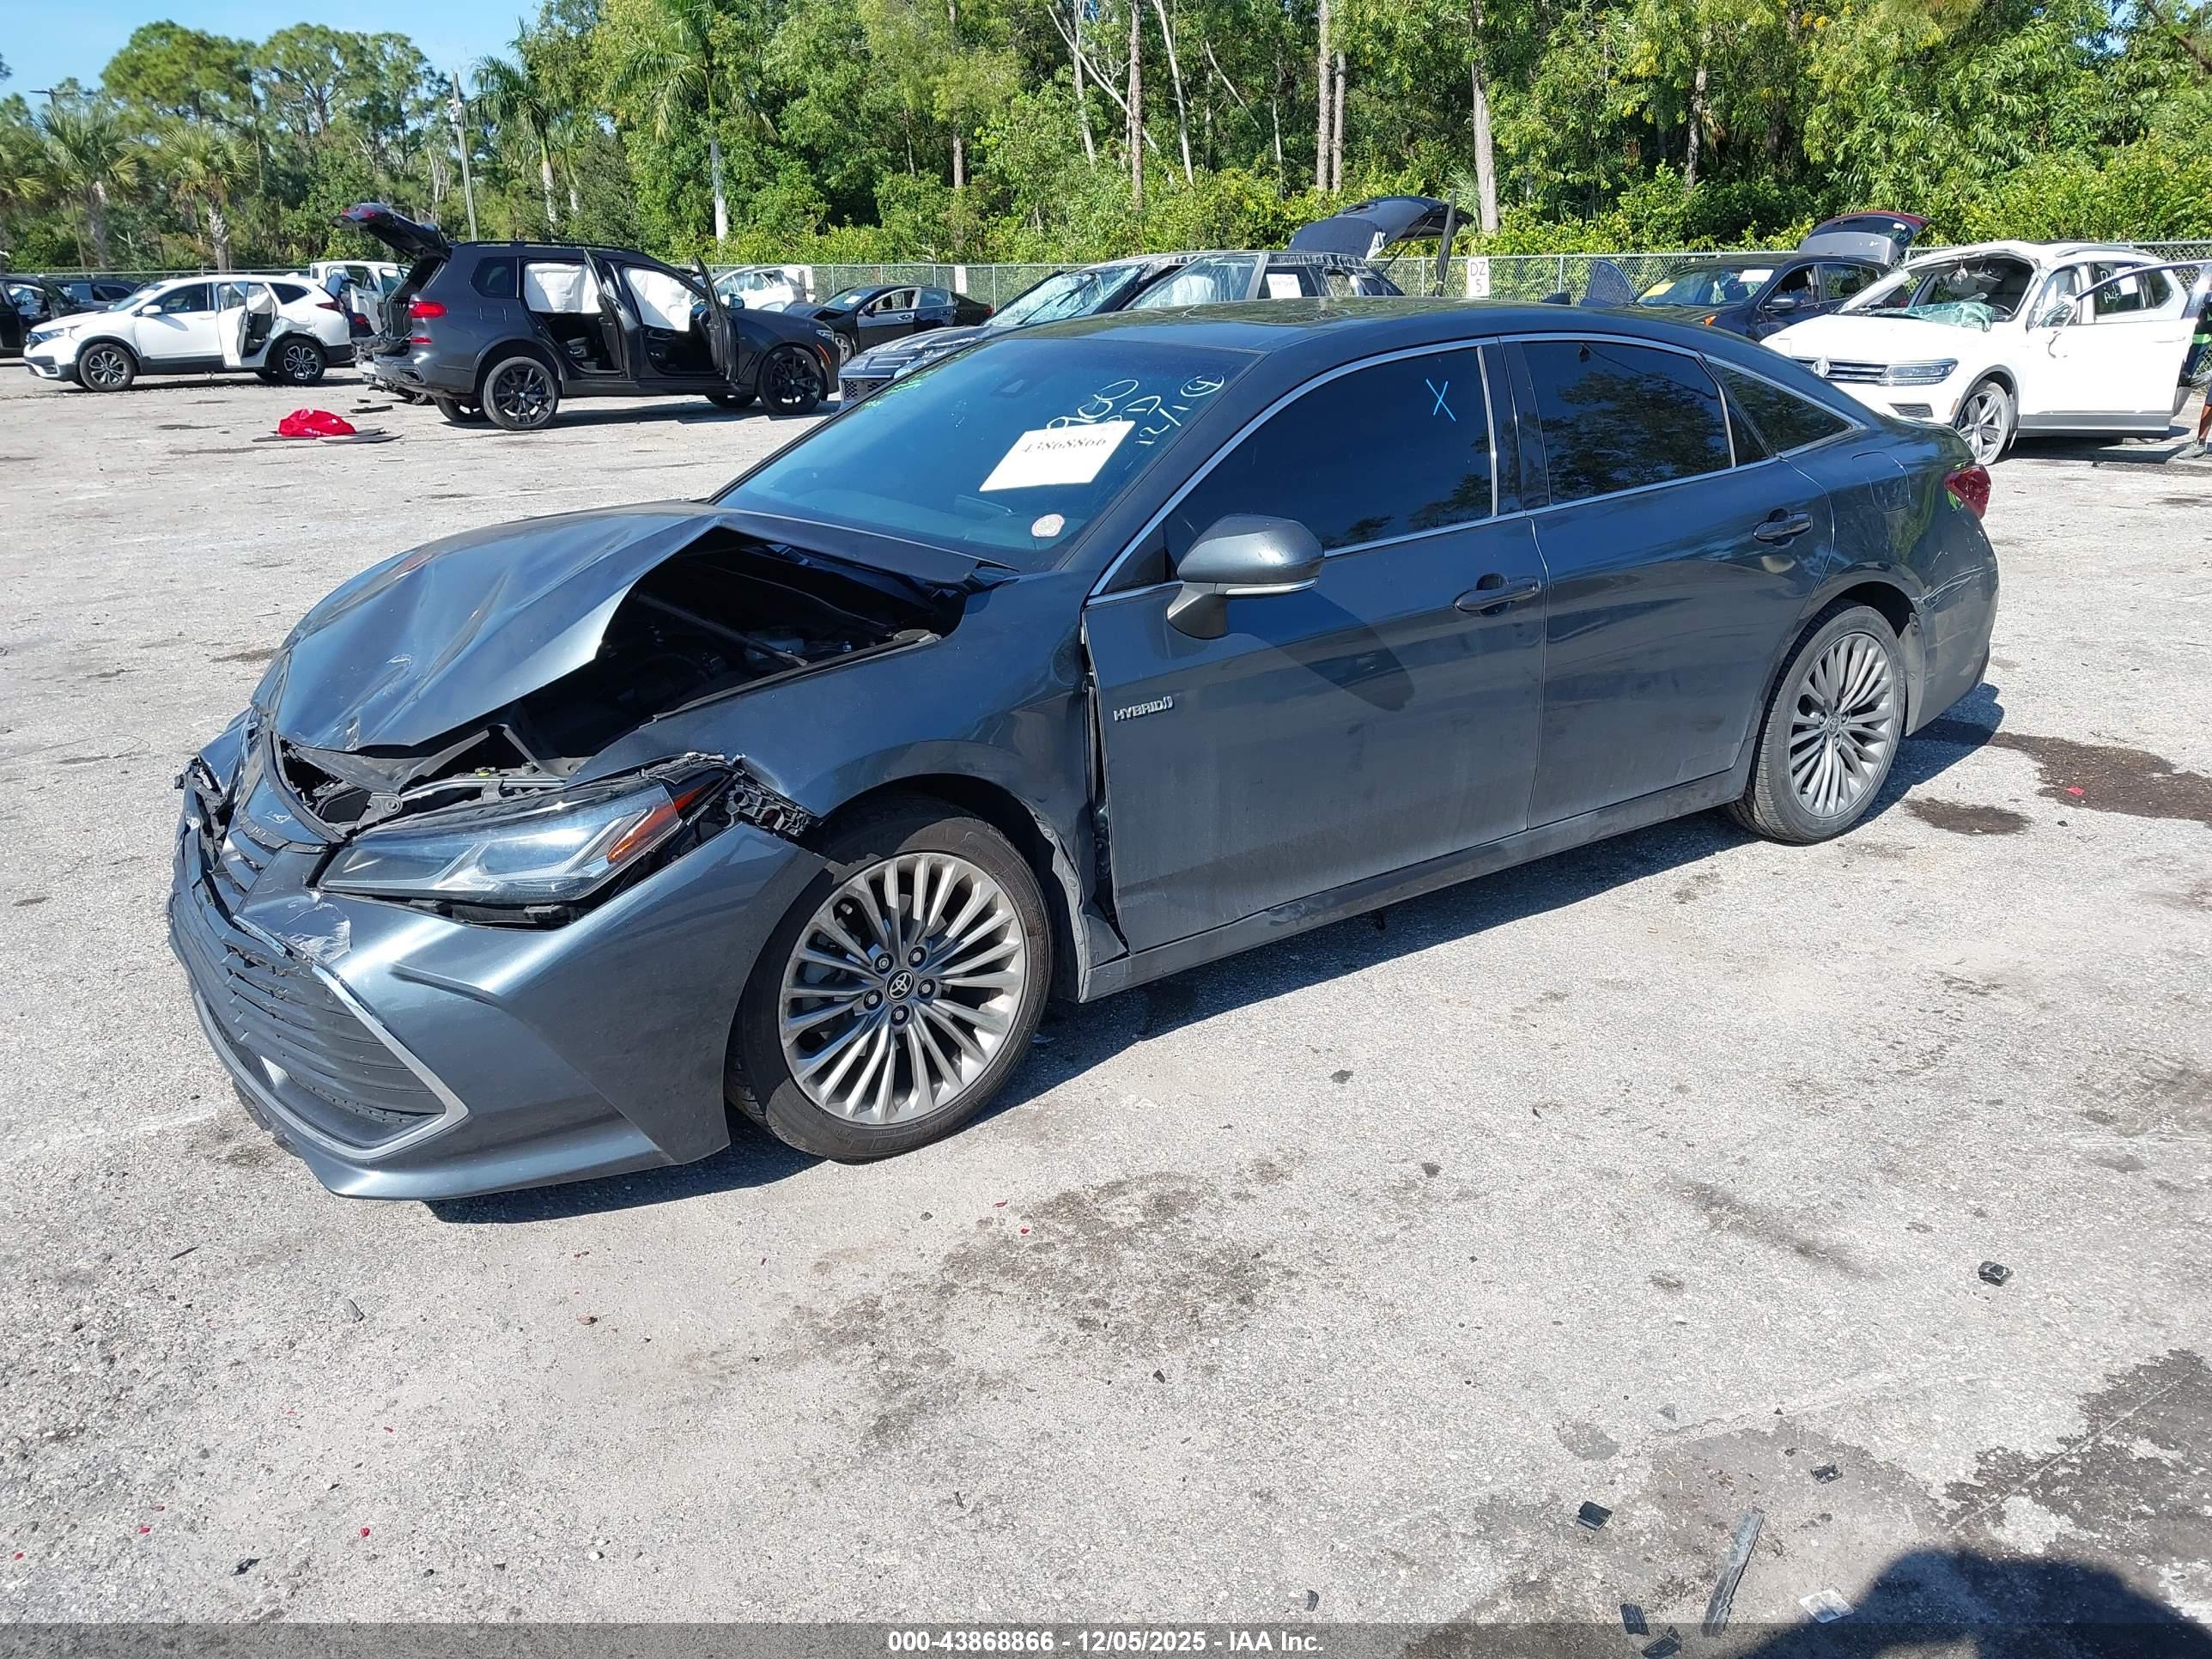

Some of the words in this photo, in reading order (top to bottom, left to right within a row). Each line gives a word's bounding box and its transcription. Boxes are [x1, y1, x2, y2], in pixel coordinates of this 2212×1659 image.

[1470, 261, 1486, 276] DZ
[1476, 278, 1483, 293] 5
[1425, 379, 1456, 422] X
[1021, 436, 1108, 454] 43868866
[1113, 700, 1164, 722] HYBRID
